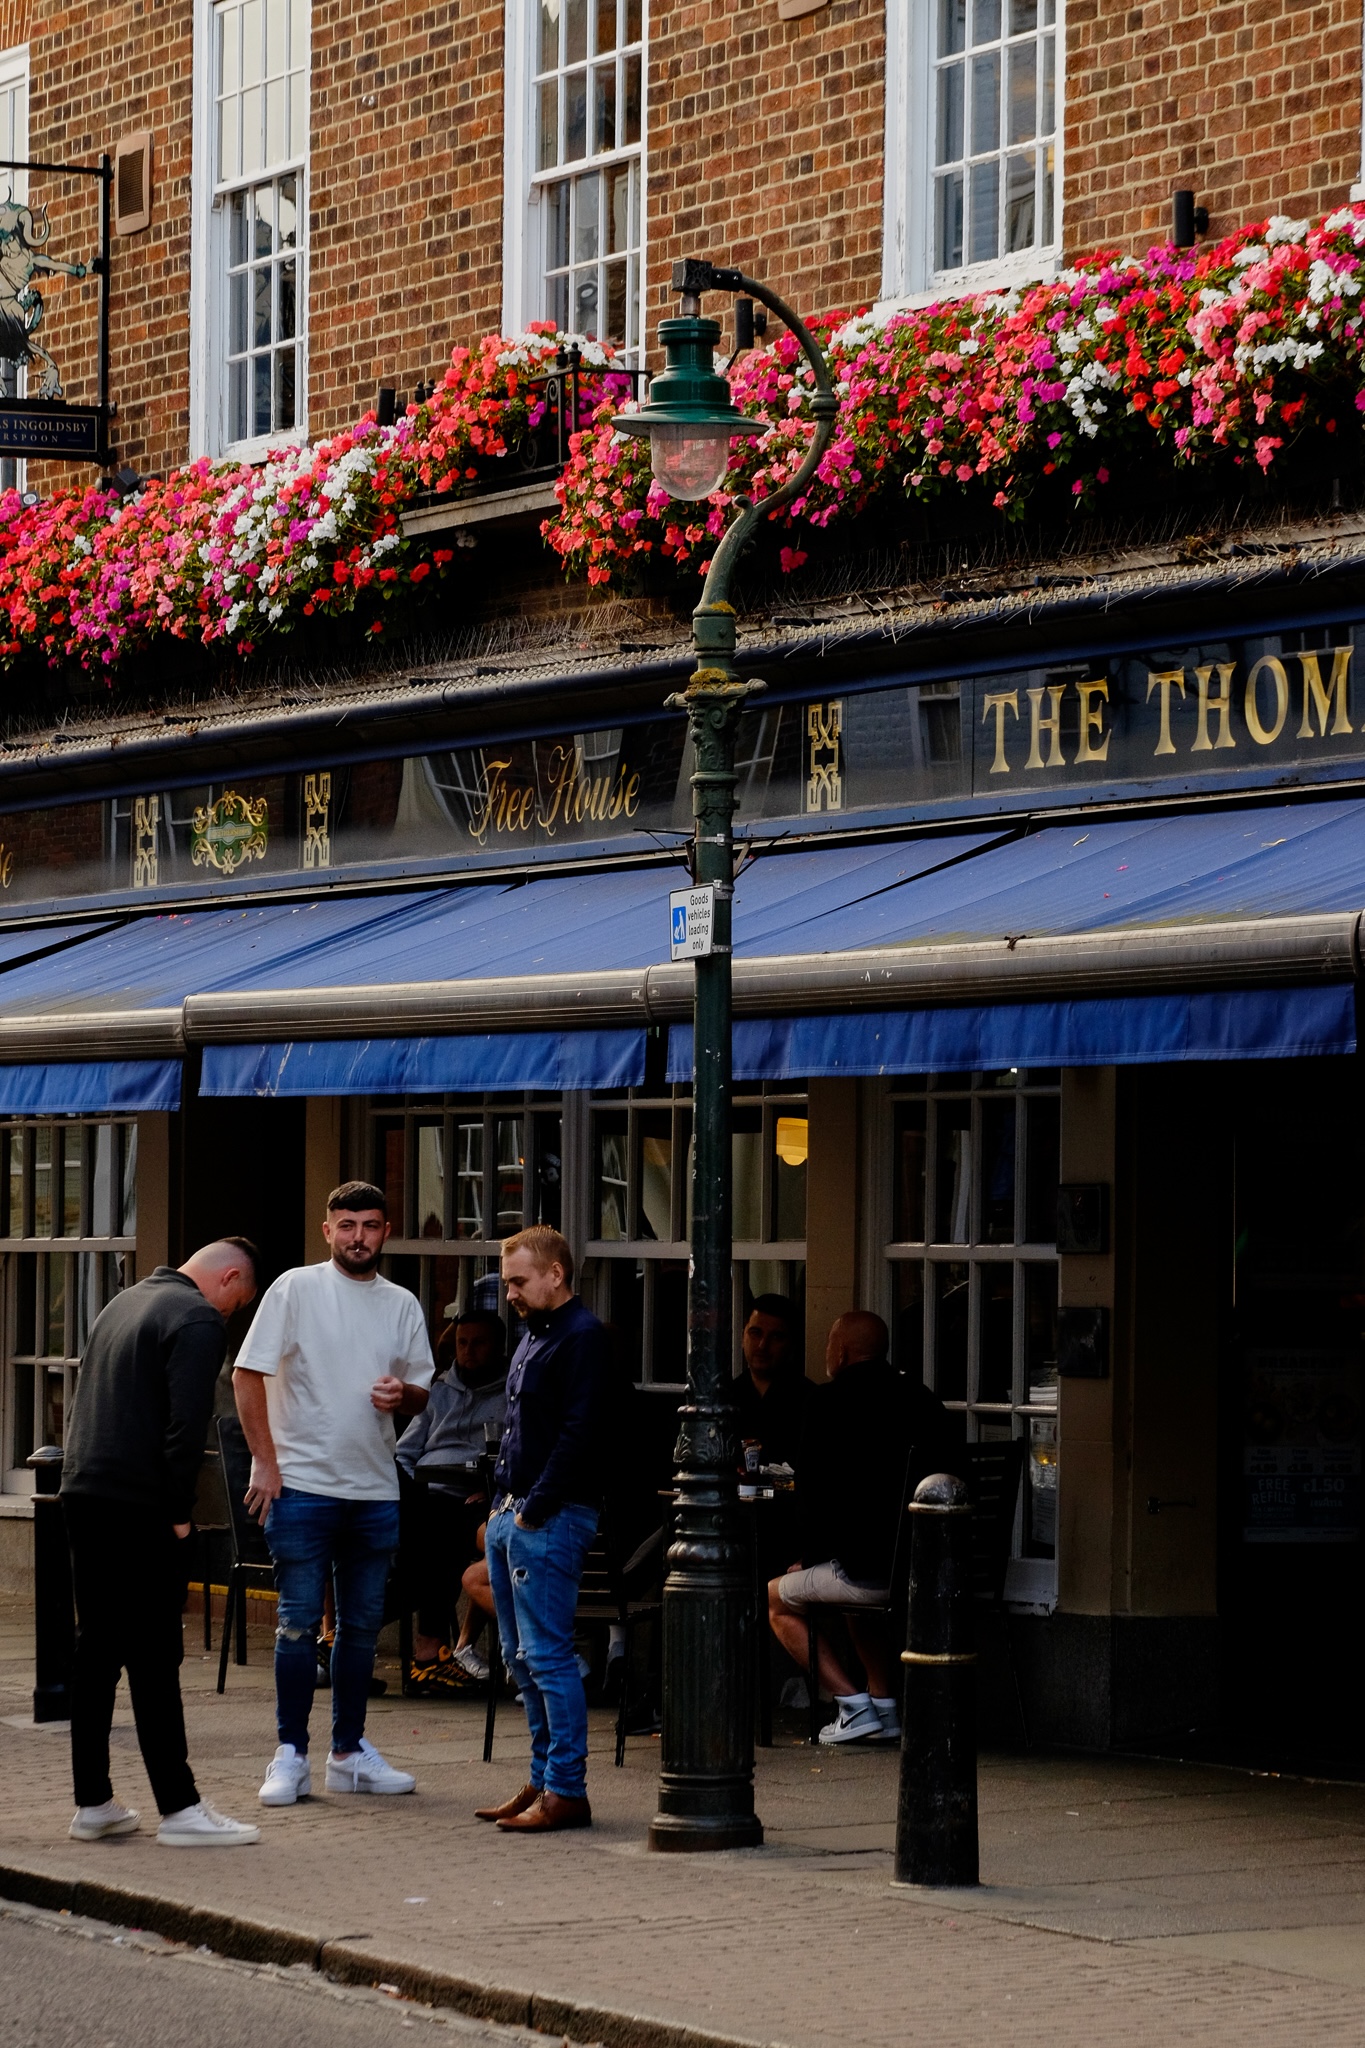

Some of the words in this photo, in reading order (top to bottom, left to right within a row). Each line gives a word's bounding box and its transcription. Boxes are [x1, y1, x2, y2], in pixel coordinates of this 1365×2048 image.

[13, 419, 88, 433] INGOLDSBY
[981, 676, 1113, 774] THE
[1145, 644, 1365, 756] THOM
[468, 756, 535, 846] Free
[537, 745, 641, 837] House
[689, 892, 709, 906] Goods
[687, 908, 711, 921] vehicles
[688, 922, 709, 936] loading
[692, 938, 705, 951] only
[1257, 1477, 1291, 1491] FREE
[1303, 1477, 1345, 1493] £1.50
[1251, 1491, 1297, 1506] REFILLS
